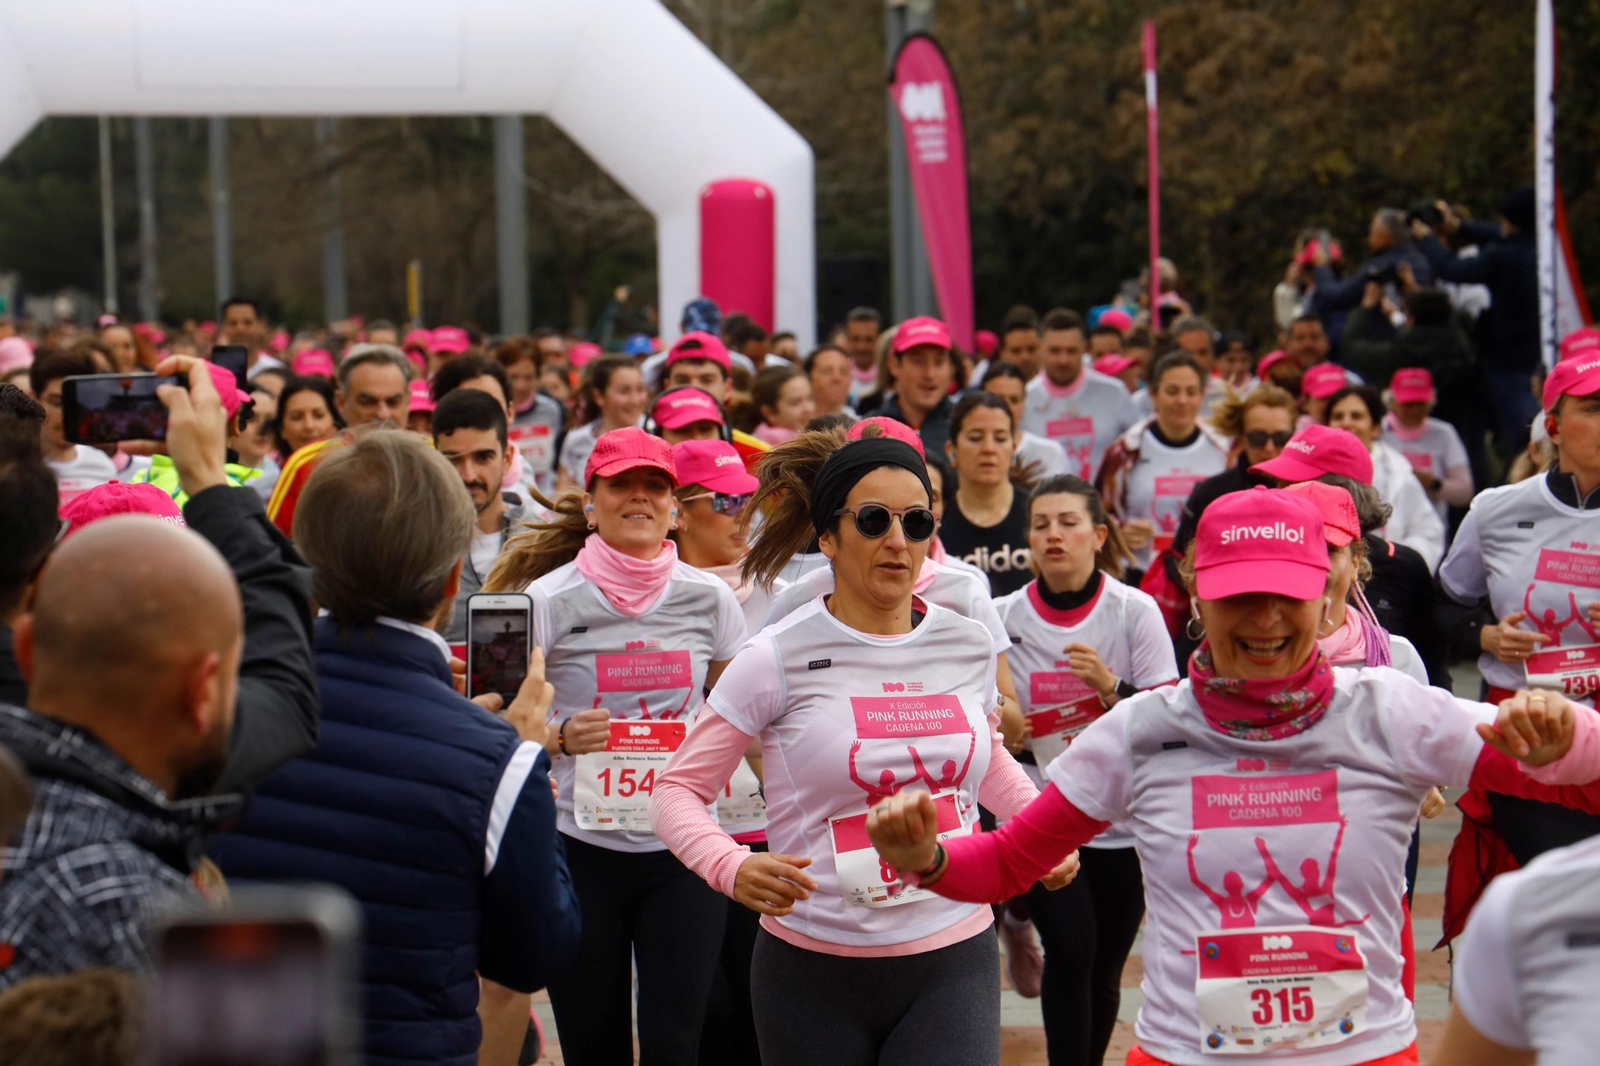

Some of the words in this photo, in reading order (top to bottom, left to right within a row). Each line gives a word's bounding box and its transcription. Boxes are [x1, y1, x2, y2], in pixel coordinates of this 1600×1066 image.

[1221, 522, 1304, 544] sinvello!
[957, 543, 1032, 573] dida
[608, 667, 633, 677] PINK
[635, 664, 682, 677] RUNNING
[622, 678, 655, 686] CADENA
[658, 676, 670, 684] 100
[882, 682, 905, 692] 100
[889, 702, 895, 710] X
[897, 700, 926, 710] Edición
[866, 711, 895, 722] PINK
[900, 708, 955, 721] RUNNING
[629, 725, 651, 736] 100
[886, 722, 924, 733] CADENA
[926, 721, 942, 730] 100
[1236, 758, 1266, 772] 100
[597, 768, 662, 797] 154
[1239, 783, 1246, 791] X
[1207, 793, 1244, 807] PINK
[1249, 787, 1322, 805] RUNNING
[1229, 808, 1279, 820] CADENA
[1282, 806, 1302, 818] 100
[1262, 935, 1293, 950] 100
[1250, 954, 1270, 963] PINK
[1271, 952, 1308, 962] RUNNING
[1251, 986, 1314, 1025] 315
